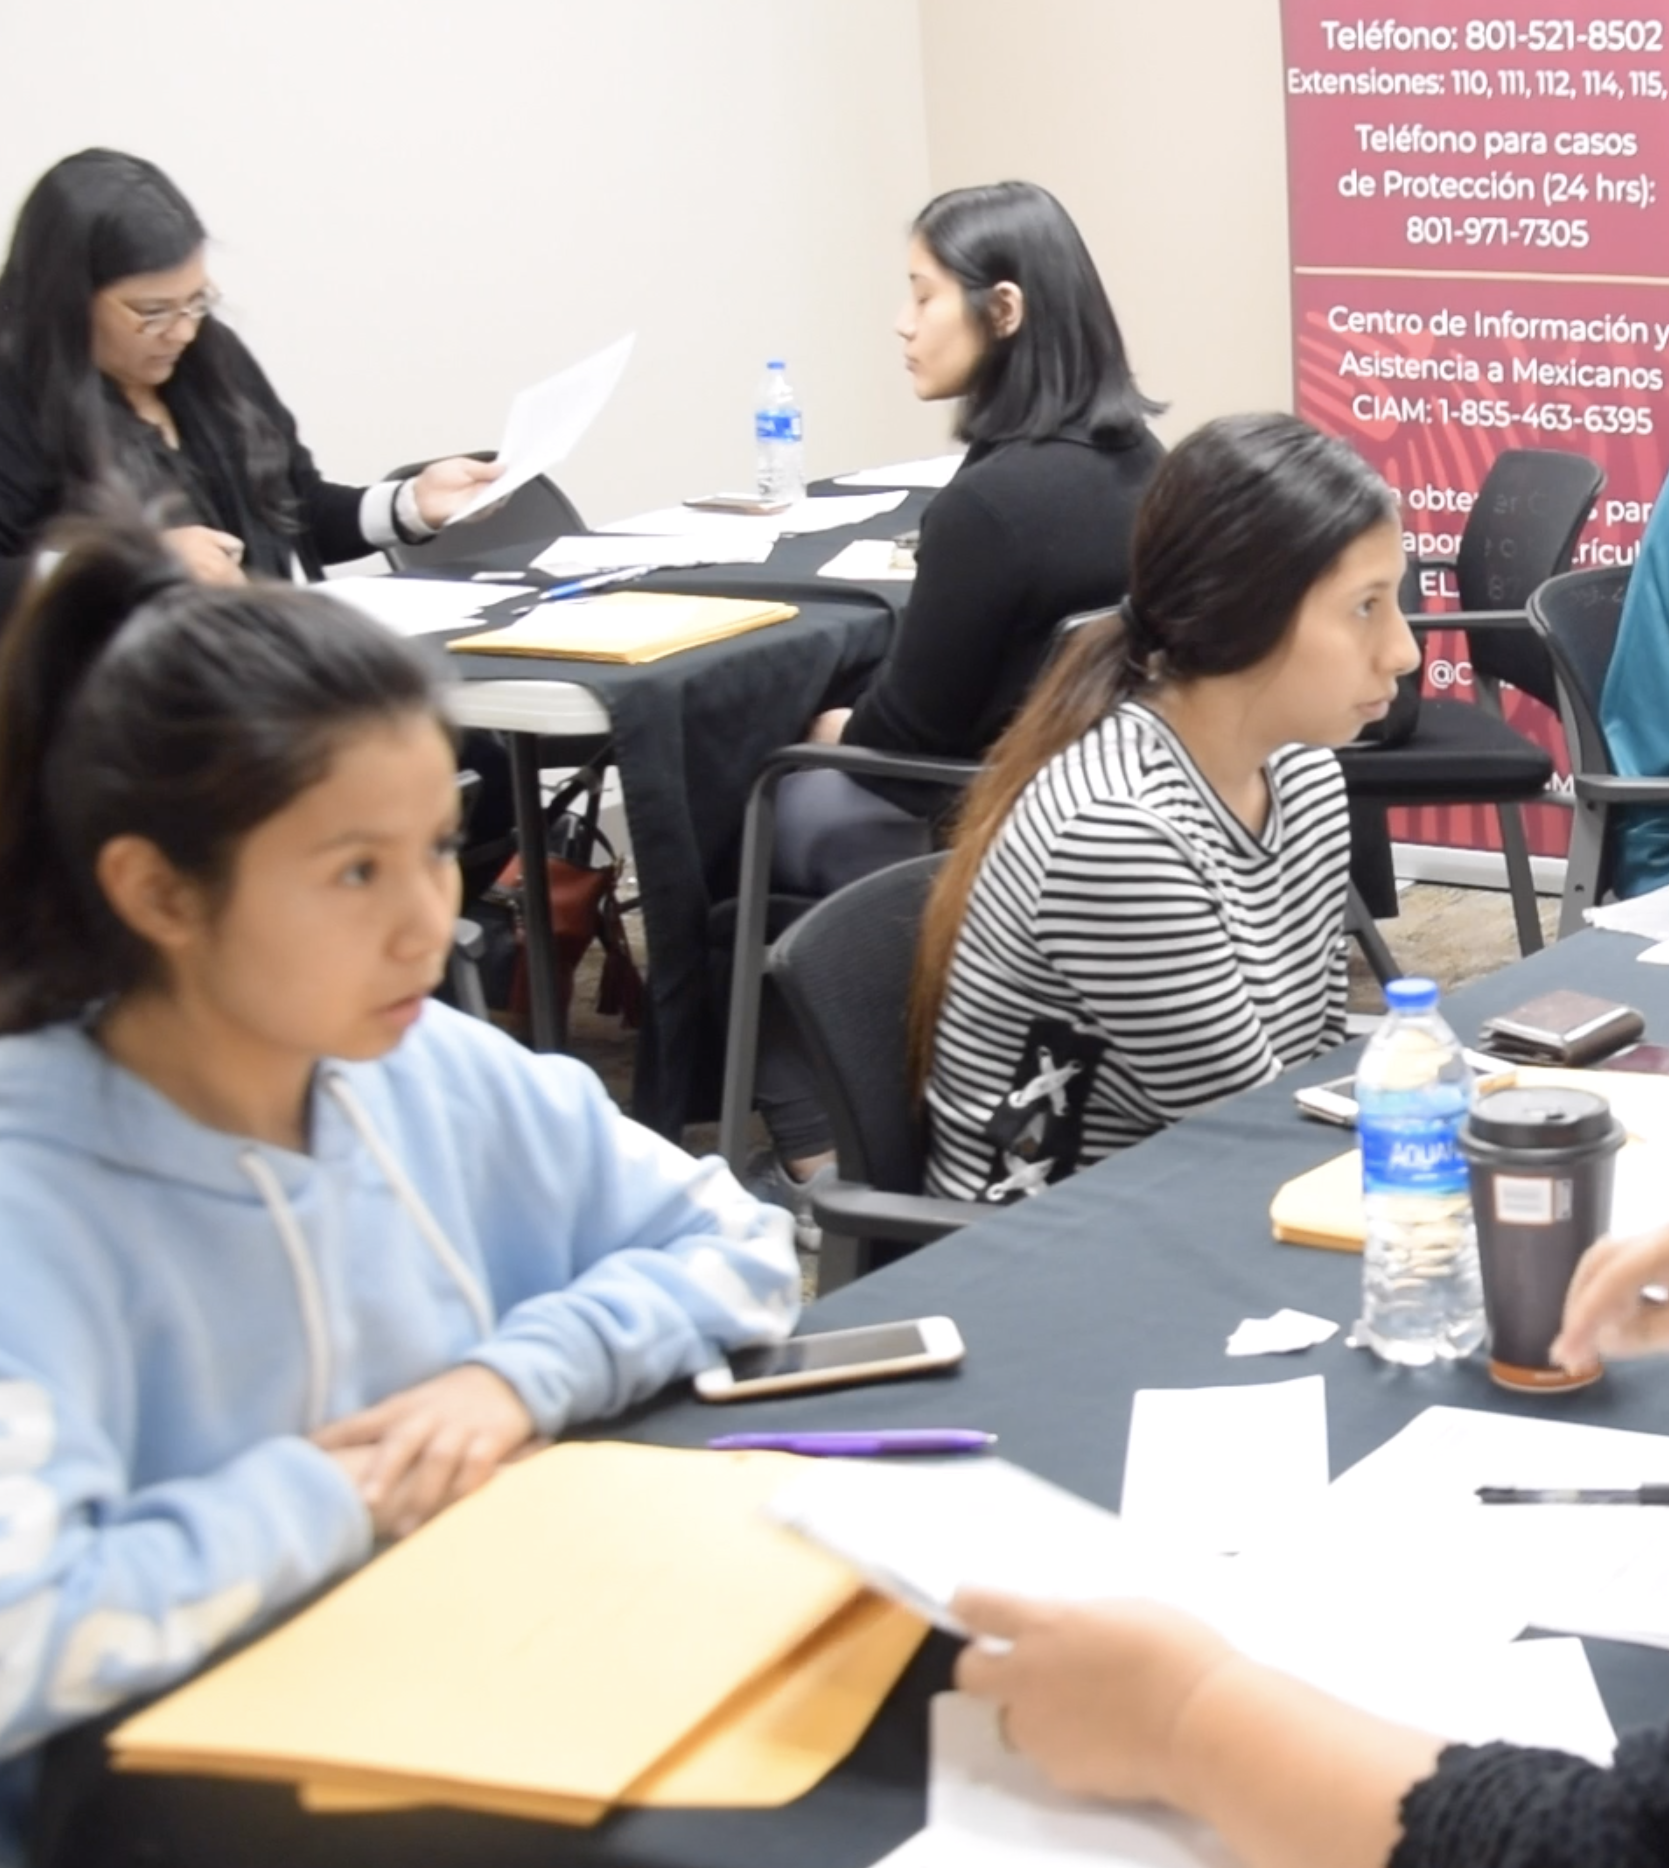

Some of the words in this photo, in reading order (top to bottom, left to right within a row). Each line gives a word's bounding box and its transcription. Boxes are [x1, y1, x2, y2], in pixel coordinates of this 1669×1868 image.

[1320, 19, 1458, 51] Teléfono:
[1465, 20, 1663, 52] 801-521-8502
[1287, 67, 1445, 95] Extensiones:
[1451, 69, 1493, 98] 110,
[1497, 70, 1532, 98] 111,
[1536, 70, 1577, 99] 112,
[1582, 70, 1625, 99] 114,
[1629, 70, 1668, 100] 115,
[1354, 123, 1477, 153] Teléfono
[1484, 131, 1547, 159] para
[1554, 132, 1638, 156] casos
[1338, 169, 1376, 197] de
[1383, 170, 1535, 200] Protección
[1543, 172, 1589, 206] (24
[1596, 173, 1656, 209] hrs):
[1406, 216, 1590, 248] 801-971-7305
[1327, 305, 1423, 335] Centro
[1429, 308, 1467, 337] de
[1475, 310, 1648, 343] Información
[1339, 350, 1480, 382] Asistencia
[1487, 361, 1504, 383] a
[1512, 357, 1664, 390] Mexicanos
[1352, 394, 1432, 424] CIAM:
[1438, 398, 1654, 435] 1-855-463-6395
[1606, 499, 1653, 526] par
[1571, 536, 1641, 566] rícul
[1389, 1140, 1456, 1171] AQUA
